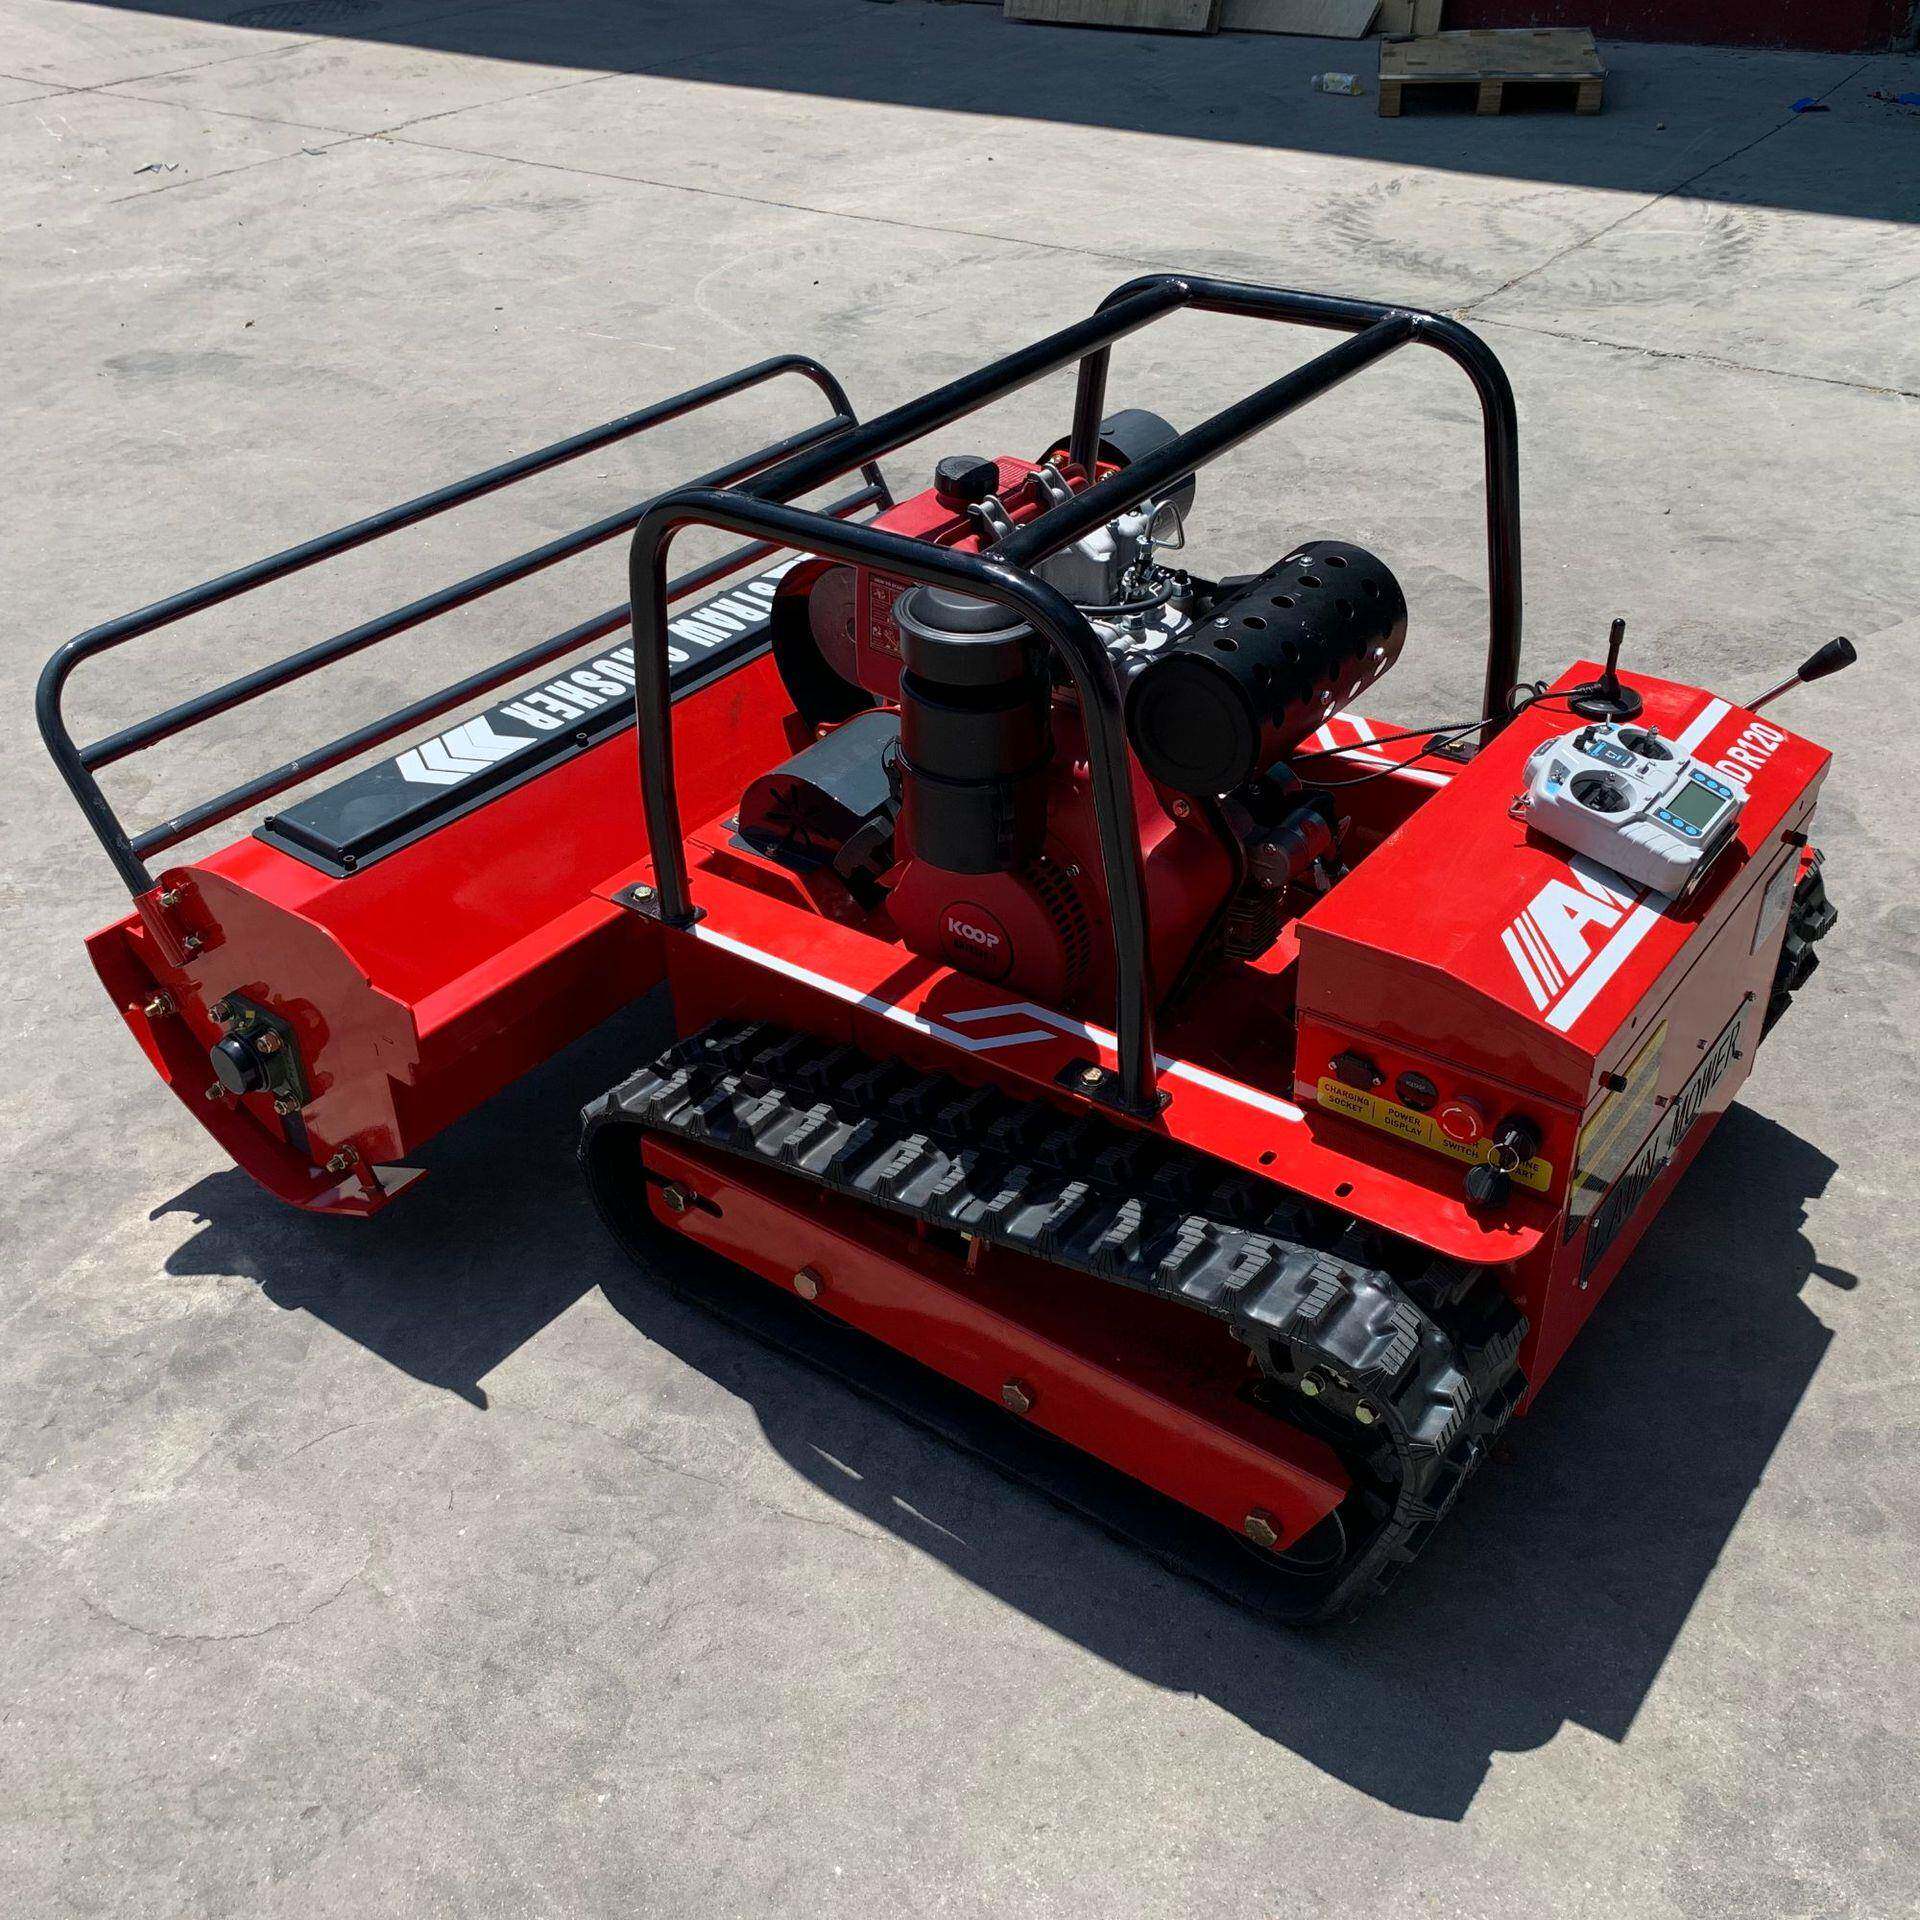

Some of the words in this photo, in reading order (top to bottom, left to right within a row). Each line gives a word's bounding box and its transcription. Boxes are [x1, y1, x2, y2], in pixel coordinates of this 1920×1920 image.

[668, 581, 777, 648] STRAW
[1715, 722, 1784, 784] DR120
[948, 916, 1000, 948] KOOP
[1324, 1083, 1370, 1107] CHARGING
[1668, 1020, 1741, 1149] MOWER
[1328, 1095, 1364, 1114] SOCKET
[1384, 1117, 1422, 1137] DISPLAY
[1388, 1108, 1422, 1126] POWER
[1443, 1139, 1478, 1158] SWITCH
